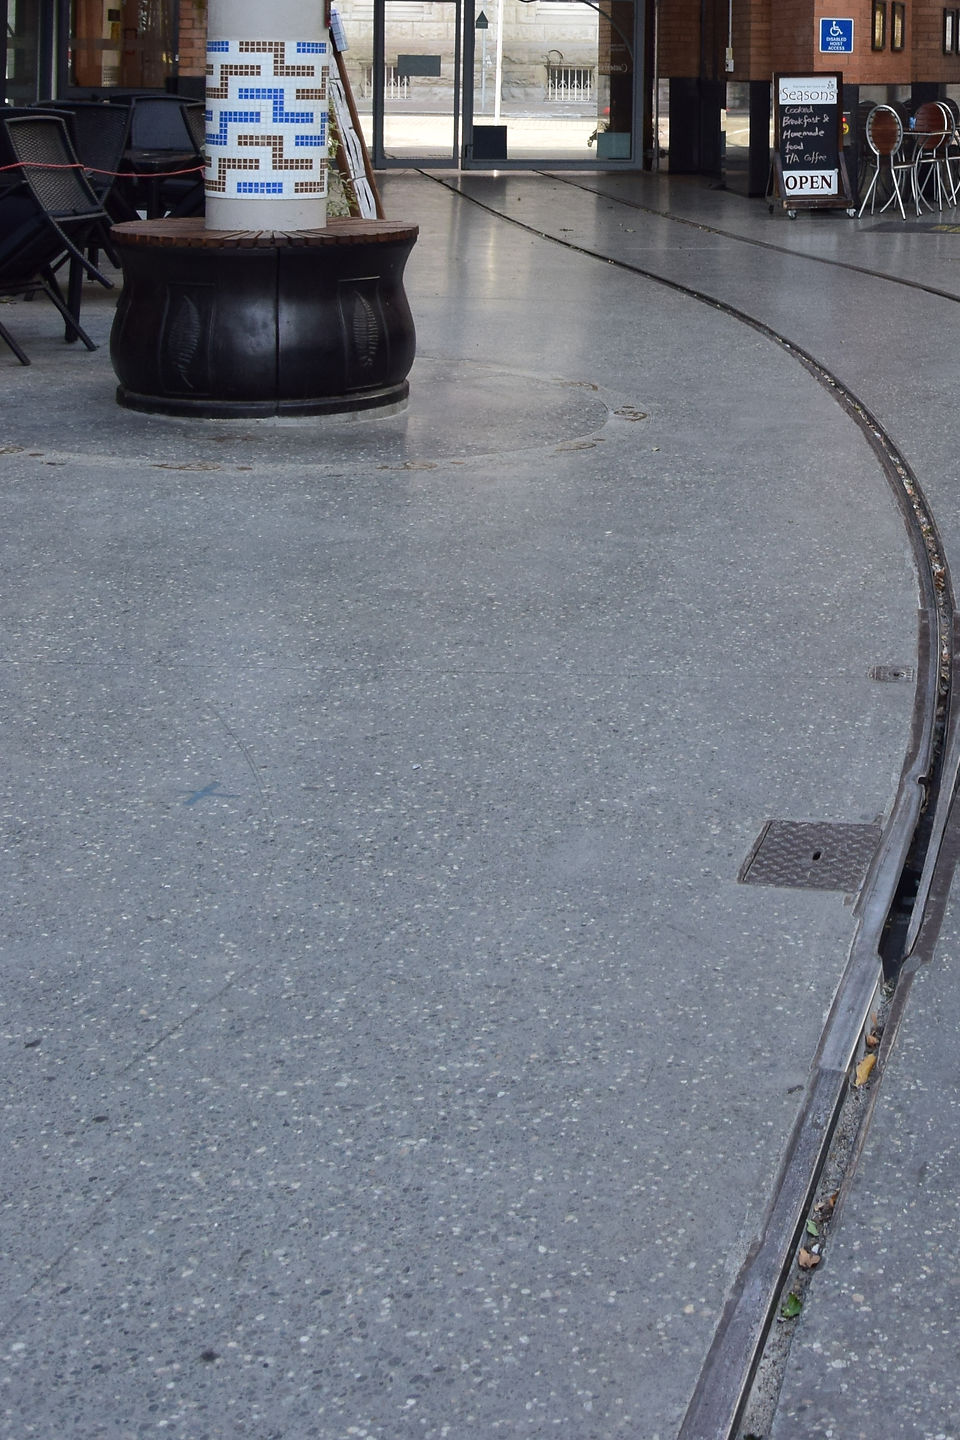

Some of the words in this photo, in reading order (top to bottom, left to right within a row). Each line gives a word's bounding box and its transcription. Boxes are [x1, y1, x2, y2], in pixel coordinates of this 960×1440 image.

[781, 87, 835, 101] Seasons
[784, 105, 814, 114] Cooked
[782, 115, 820, 127] Breakfast
[822, 113, 830, 123] &
[782, 126, 825, 139] Homemade
[785, 141, 804, 153] food
[785, 174, 833, 191] OPEN
